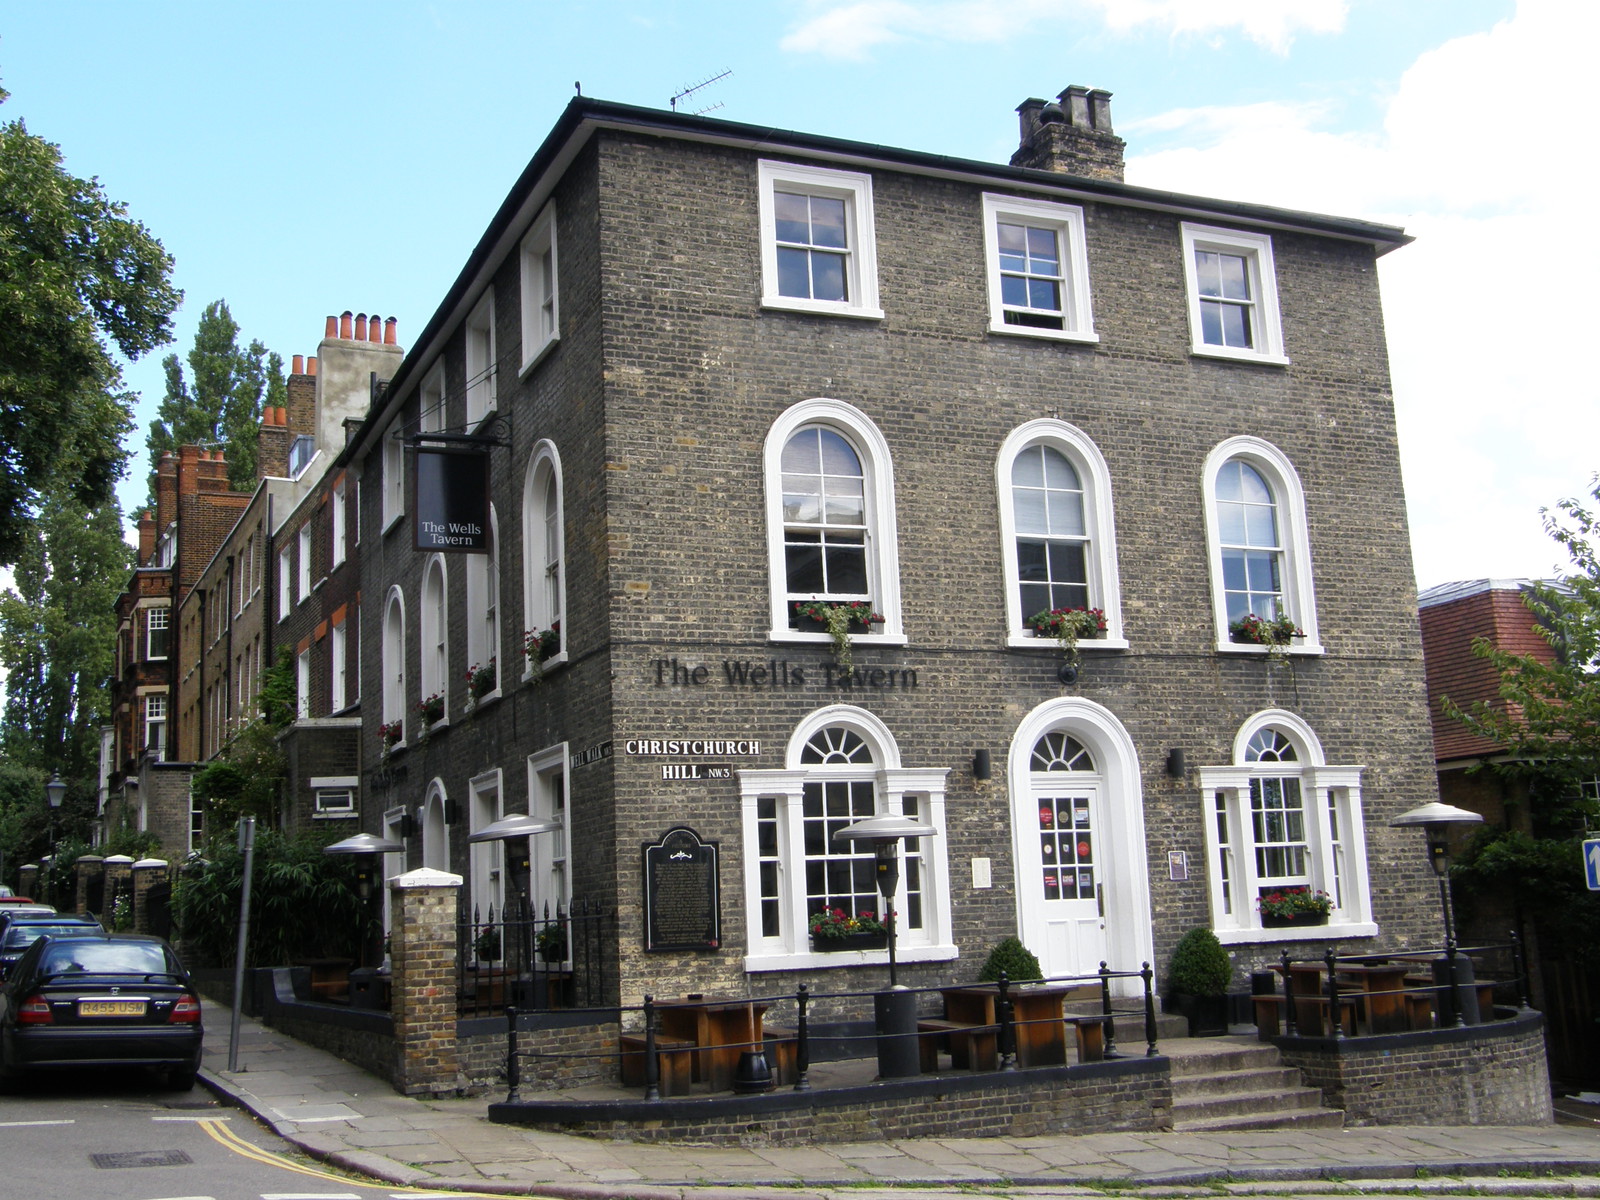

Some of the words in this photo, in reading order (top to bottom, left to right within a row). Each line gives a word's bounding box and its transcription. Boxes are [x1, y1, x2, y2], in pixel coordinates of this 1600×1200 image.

[422, 521, 445, 533] The
[449, 522, 482, 534] Wells
[430, 533, 472, 545] Tavern
[650, 658, 710, 687] The
[722, 659, 805, 687] Wells
[819, 661, 919, 688] Tavern
[625, 740, 760, 755] CHRISTCHURCH
[662, 765, 701, 780] HILL
[82, 1002, 115, 1013] R455
[119, 1002, 143, 1013] USM
